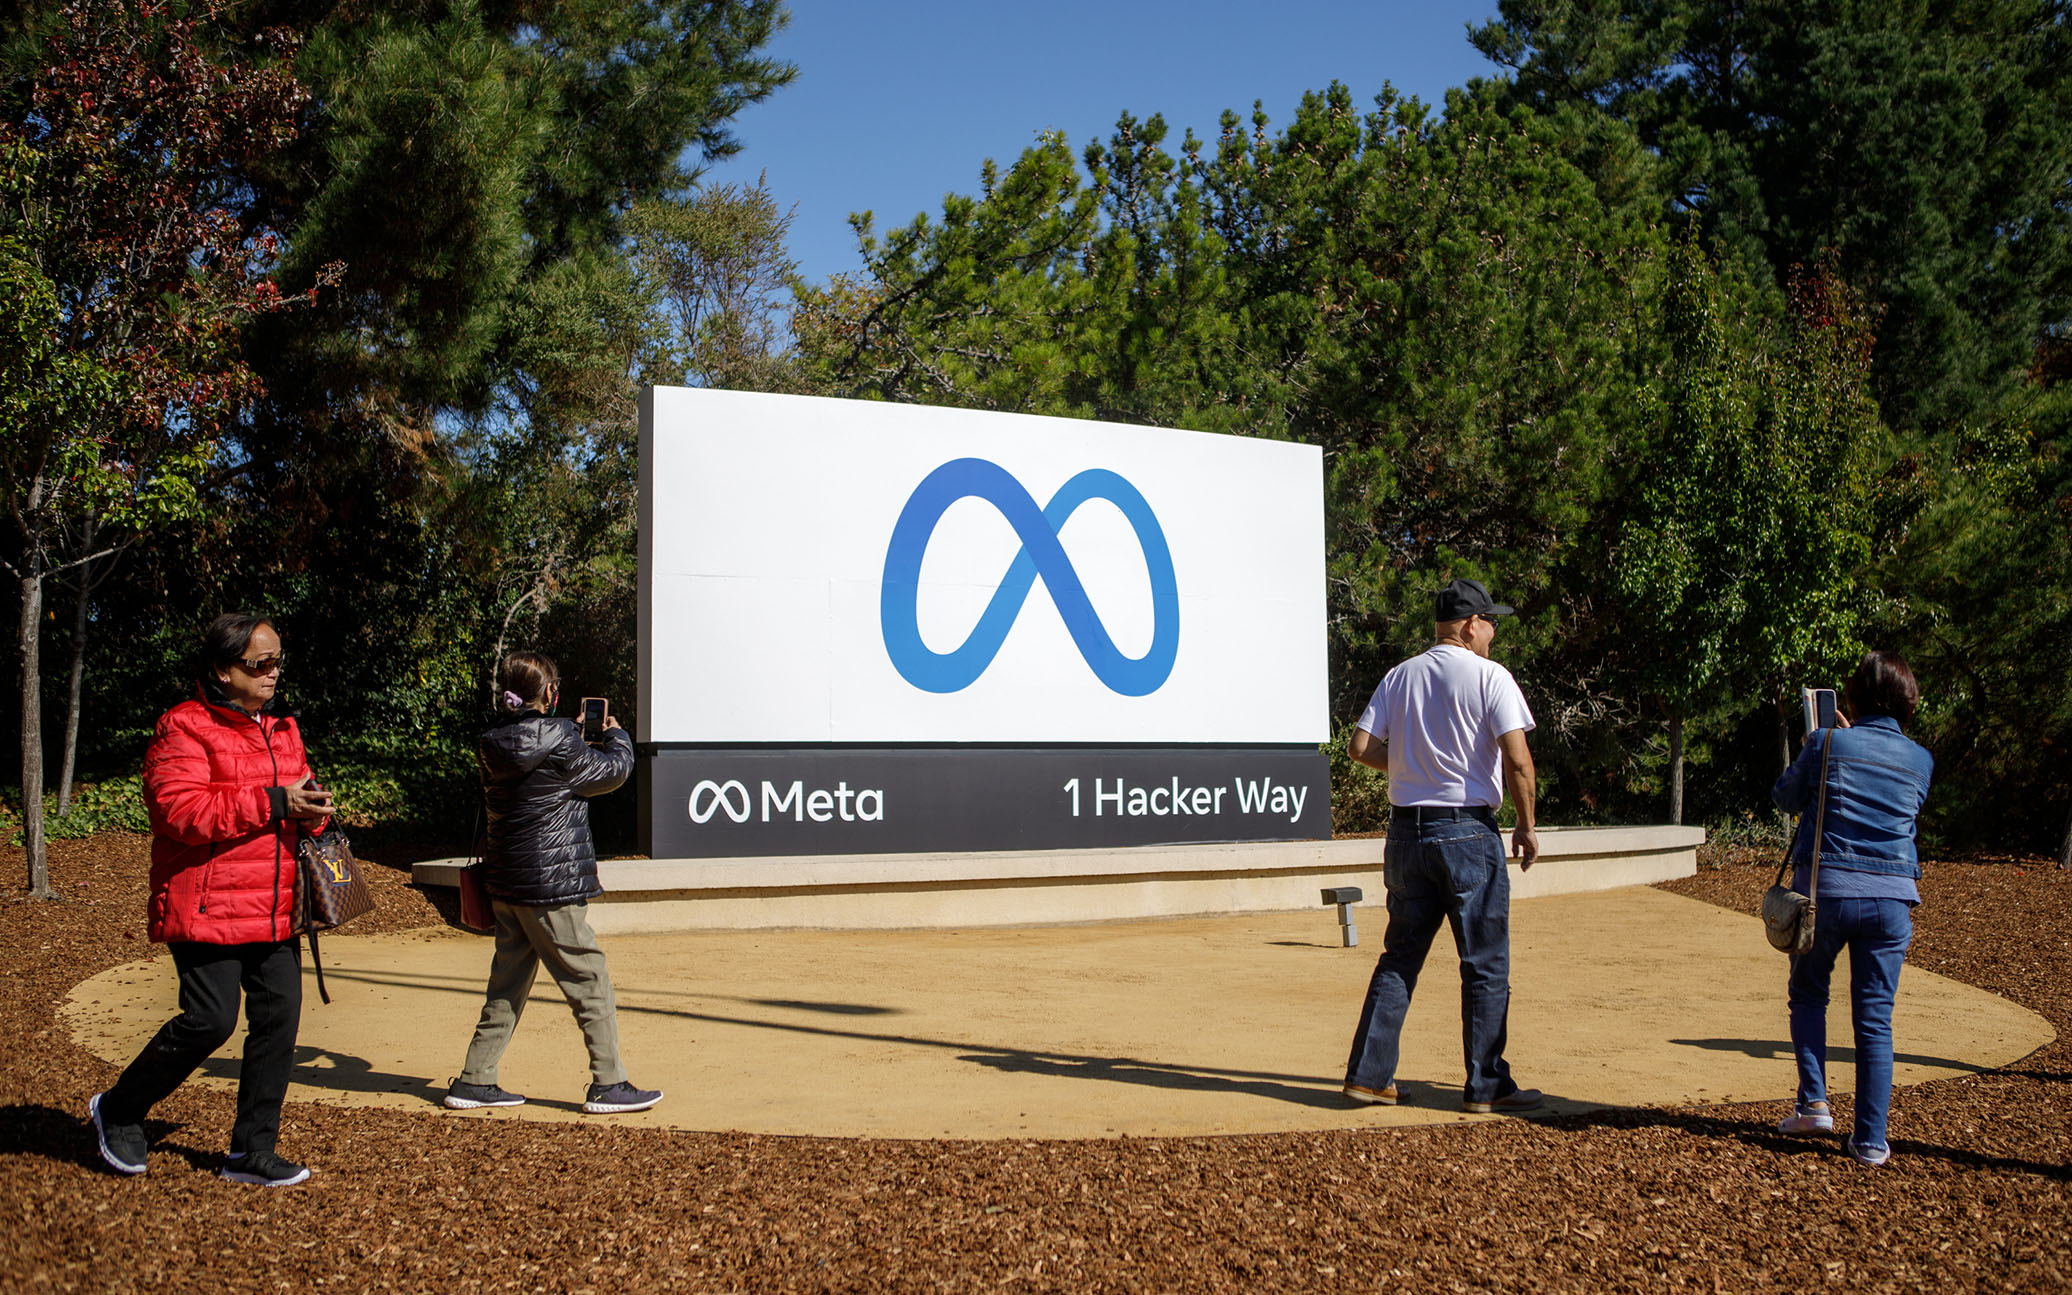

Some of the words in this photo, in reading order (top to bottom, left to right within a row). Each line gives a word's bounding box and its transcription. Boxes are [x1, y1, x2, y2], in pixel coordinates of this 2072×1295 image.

[761, 780, 884, 822] Meta
[1063, 778, 1079, 817] 1
[1095, 776, 1227, 817] Hacker
[1235, 776, 1308, 823] Way
